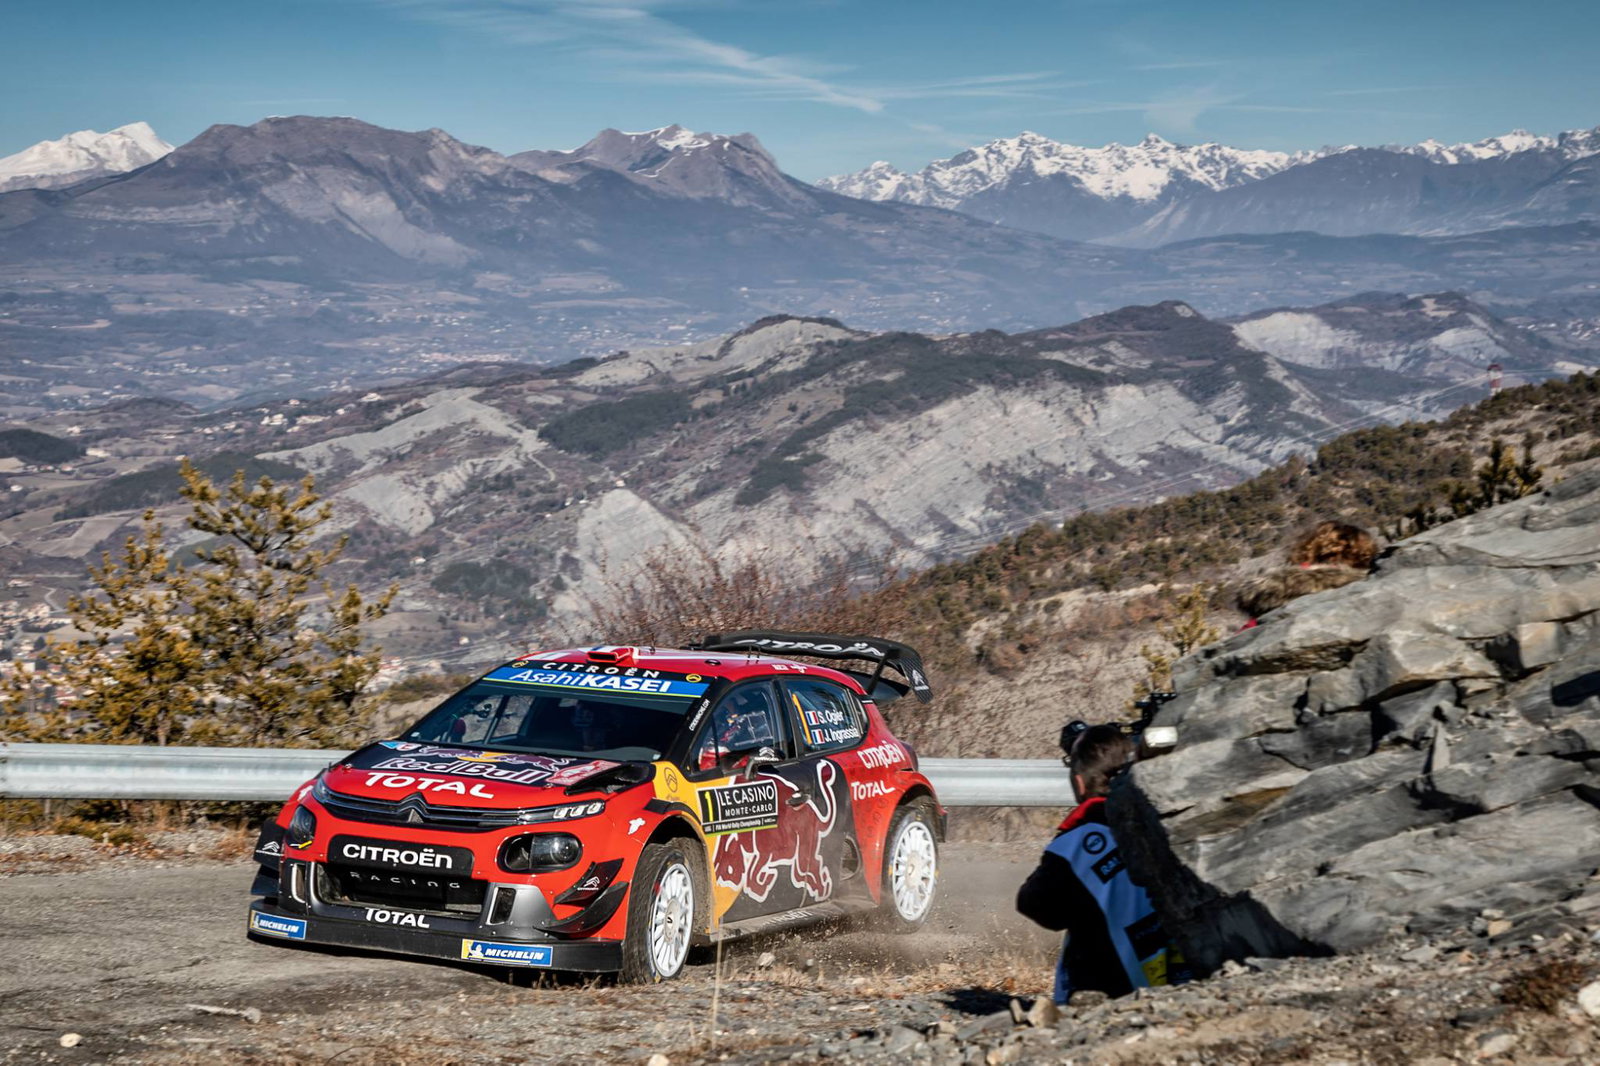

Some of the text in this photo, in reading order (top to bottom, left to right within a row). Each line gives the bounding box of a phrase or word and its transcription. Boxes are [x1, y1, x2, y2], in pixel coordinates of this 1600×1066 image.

[817, 709, 844, 725] S. Ogier
[824, 725, 859, 743] J. Ingrassia
[365, 772, 494, 799] TOTAL
[851, 780, 896, 800] TOTAL
[718, 785, 774, 806] LE CASINO
[704, 791, 714, 822] 1
[349, 871, 460, 889] RACING
[259, 919, 300, 933] MICHELIN
[365, 907, 430, 929] TOTAL
[485, 948, 544, 960] MICHELIN
